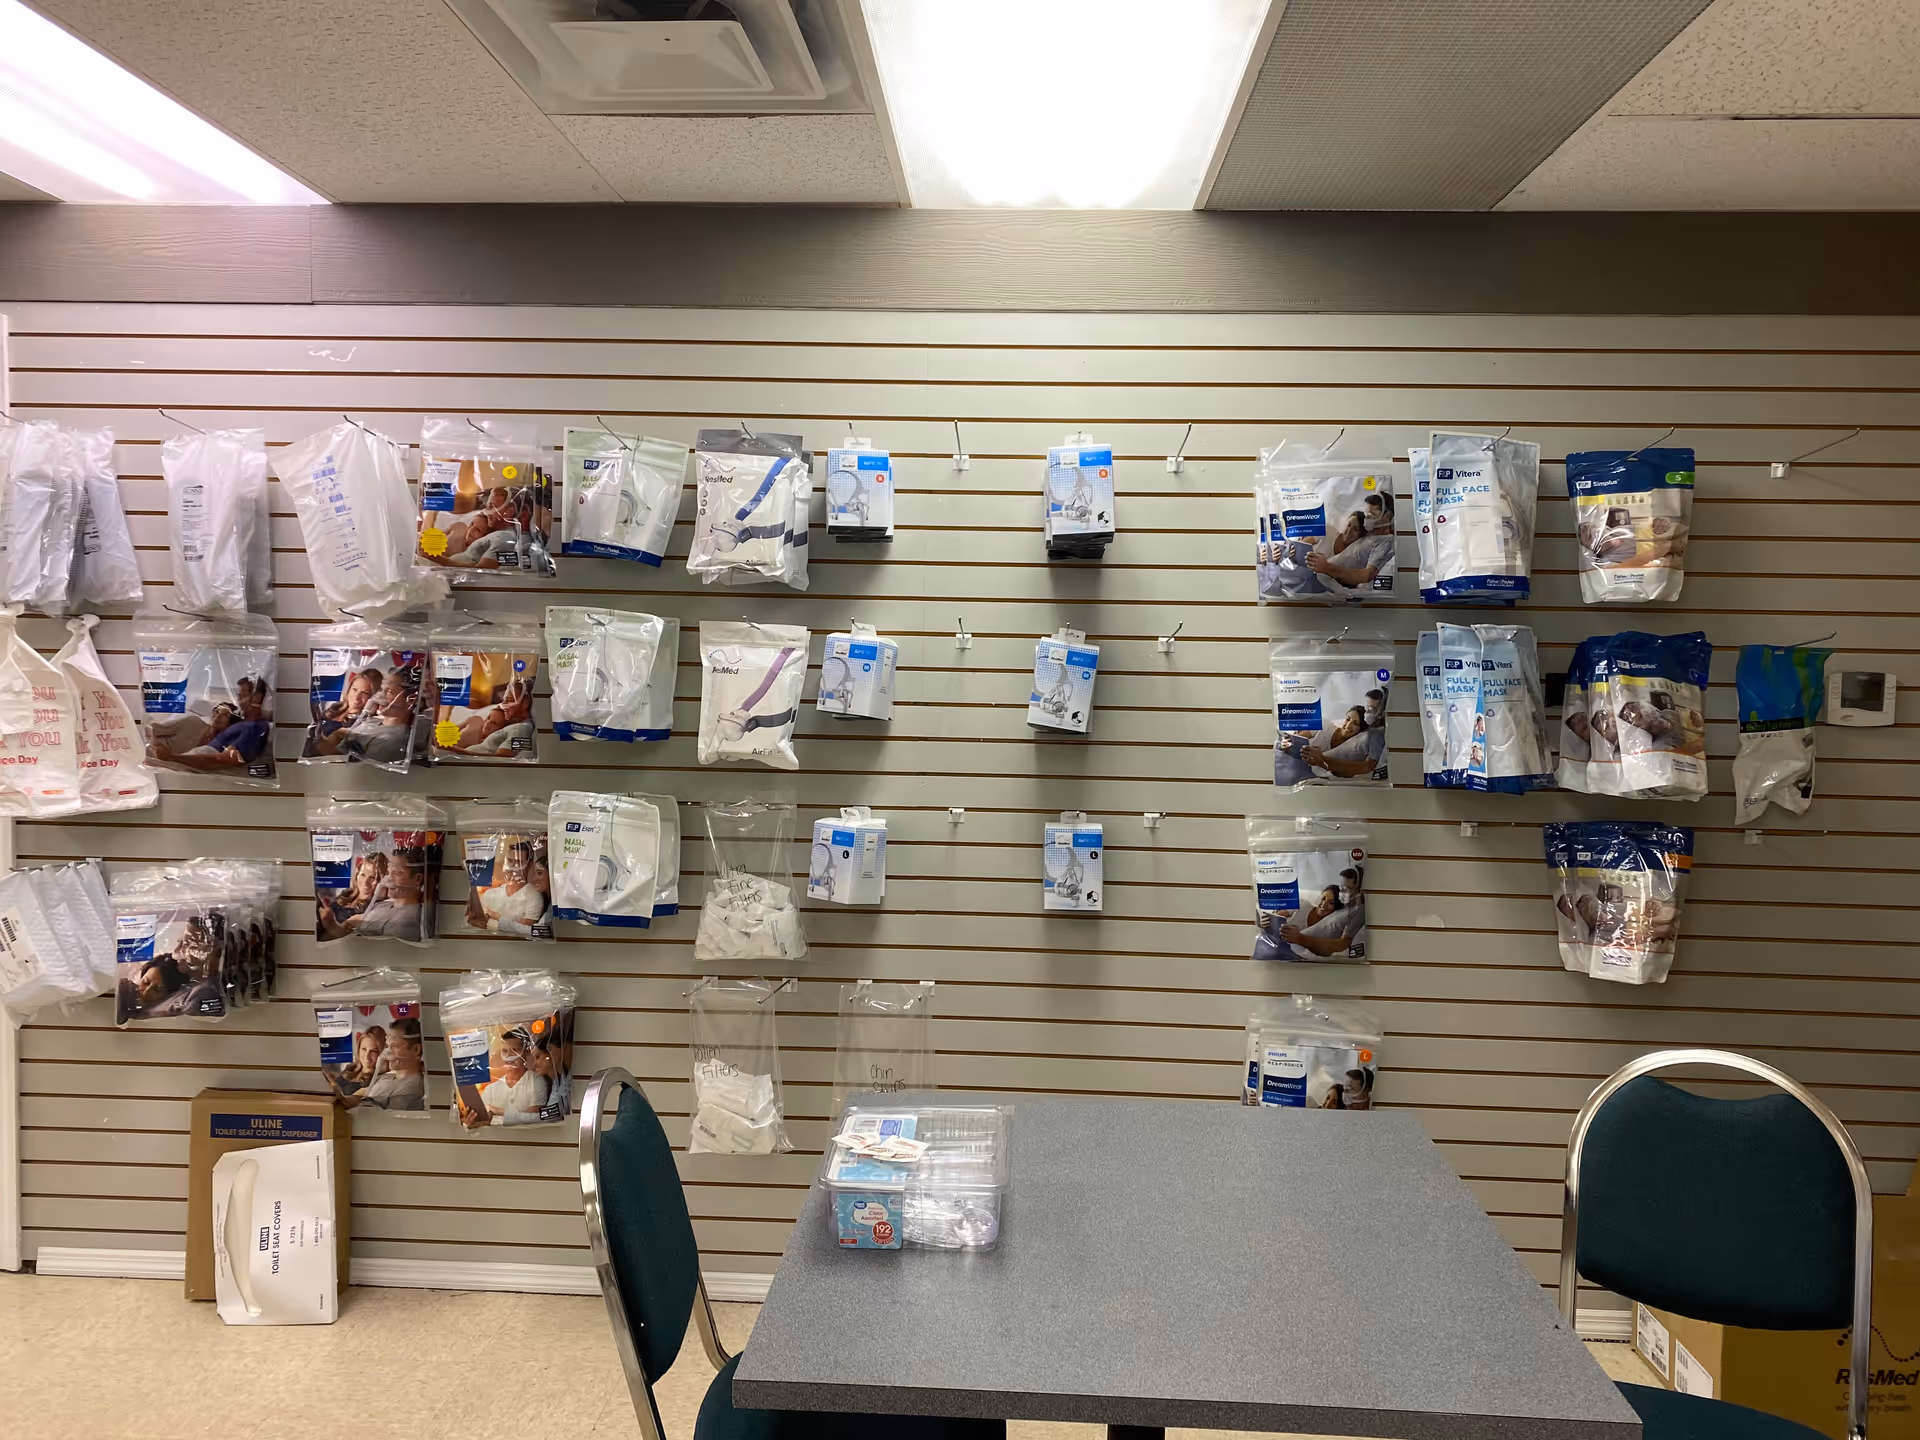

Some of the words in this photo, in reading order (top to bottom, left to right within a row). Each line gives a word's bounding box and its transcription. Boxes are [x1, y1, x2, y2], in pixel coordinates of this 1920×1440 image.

[1438, 470, 1451, 478] F&P
[1436, 488, 1460, 496] FULL
[1462, 485, 1490, 494] FACE
[1436, 496, 1464, 504] MASK
[1286, 514, 1320, 522] DreamWear
[1446, 660, 1460, 668] F&P
[1424, 667, 1439, 675] F&P
[1446, 677, 1470, 685] FULL
[32, 686, 56, 700] ou
[1448, 685, 1476, 694] MASK
[1484, 688, 1508, 697] MASK
[34, 708, 59, 723] ou
[96, 733, 132, 752] You
[18, 755, 38, 764] Day
[100, 758, 119, 768] Day
[564, 838, 586, 846] NASAL
[728, 878, 754, 896] Fine
[701, 1064, 738, 1080] Filters
[870, 1064, 893, 1079] Chin
[1266, 1080, 1302, 1090] DreamWear
[250, 1118, 283, 1128] ULINE
[876, 1224, 892, 1234] 192
[260, 1228, 269, 1250] ULINE
[1835, 1368, 1920, 1386] RsMed
